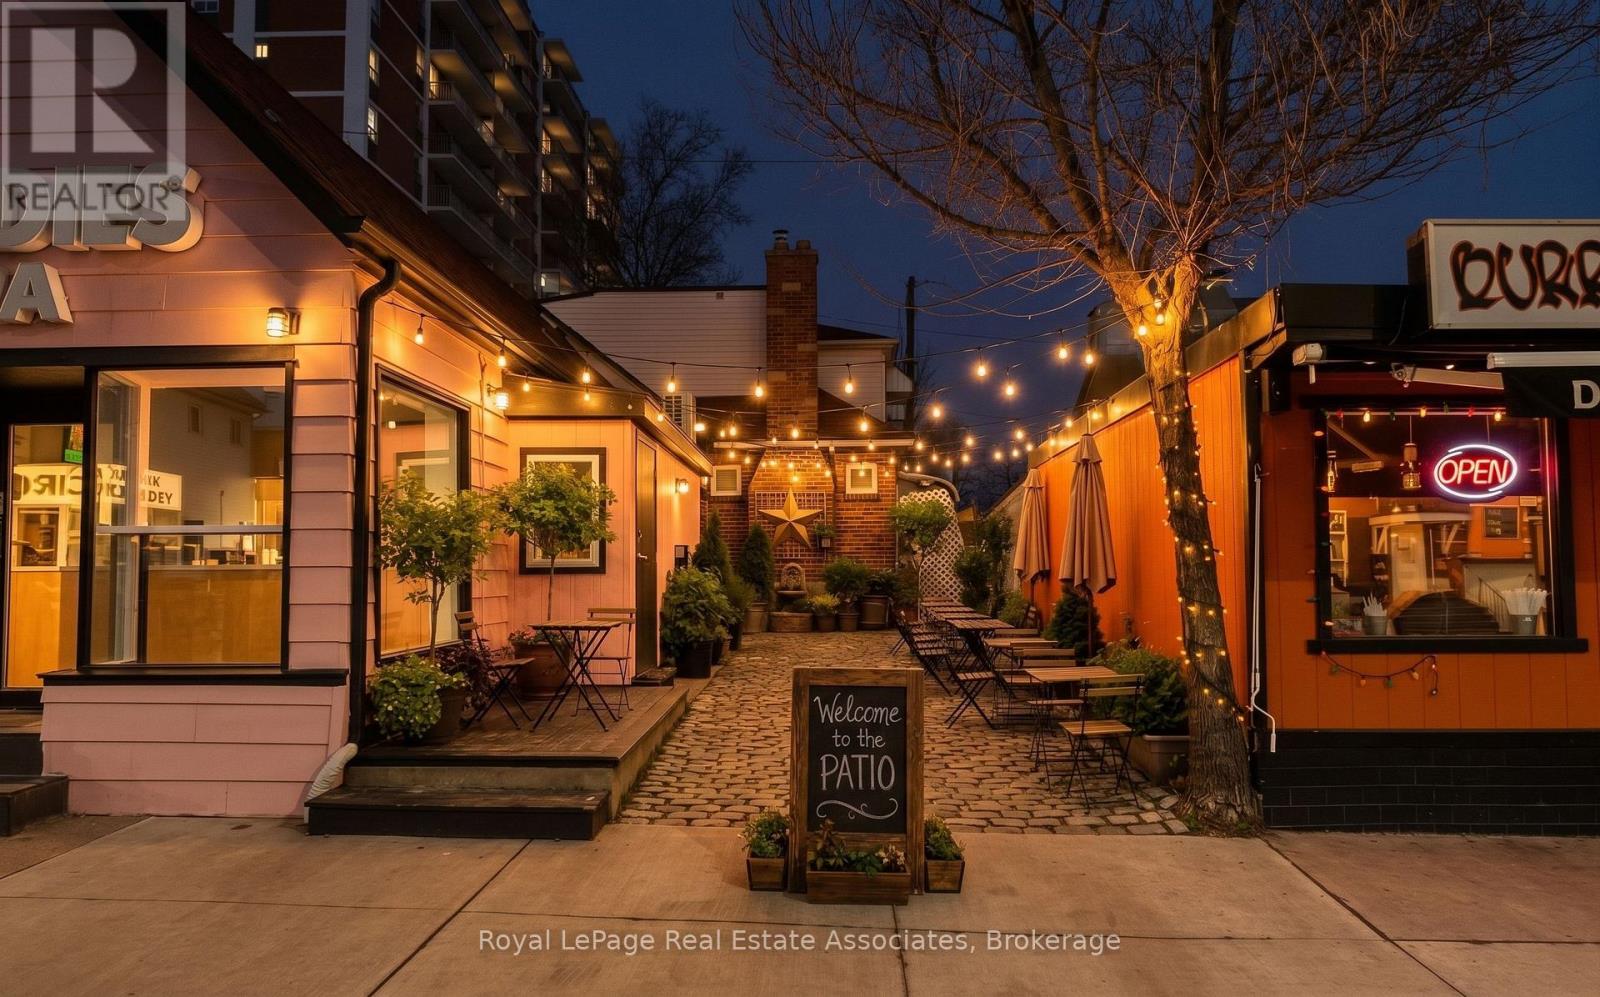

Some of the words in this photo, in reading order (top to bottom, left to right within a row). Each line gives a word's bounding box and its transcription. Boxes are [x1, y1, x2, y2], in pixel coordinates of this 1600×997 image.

[1437, 458, 1509, 485] OPEN
[813, 692, 902, 726] Welcome
[832, 728, 850, 747] to
[857, 728, 885, 748] the
[820, 753, 896, 791] PATIO
